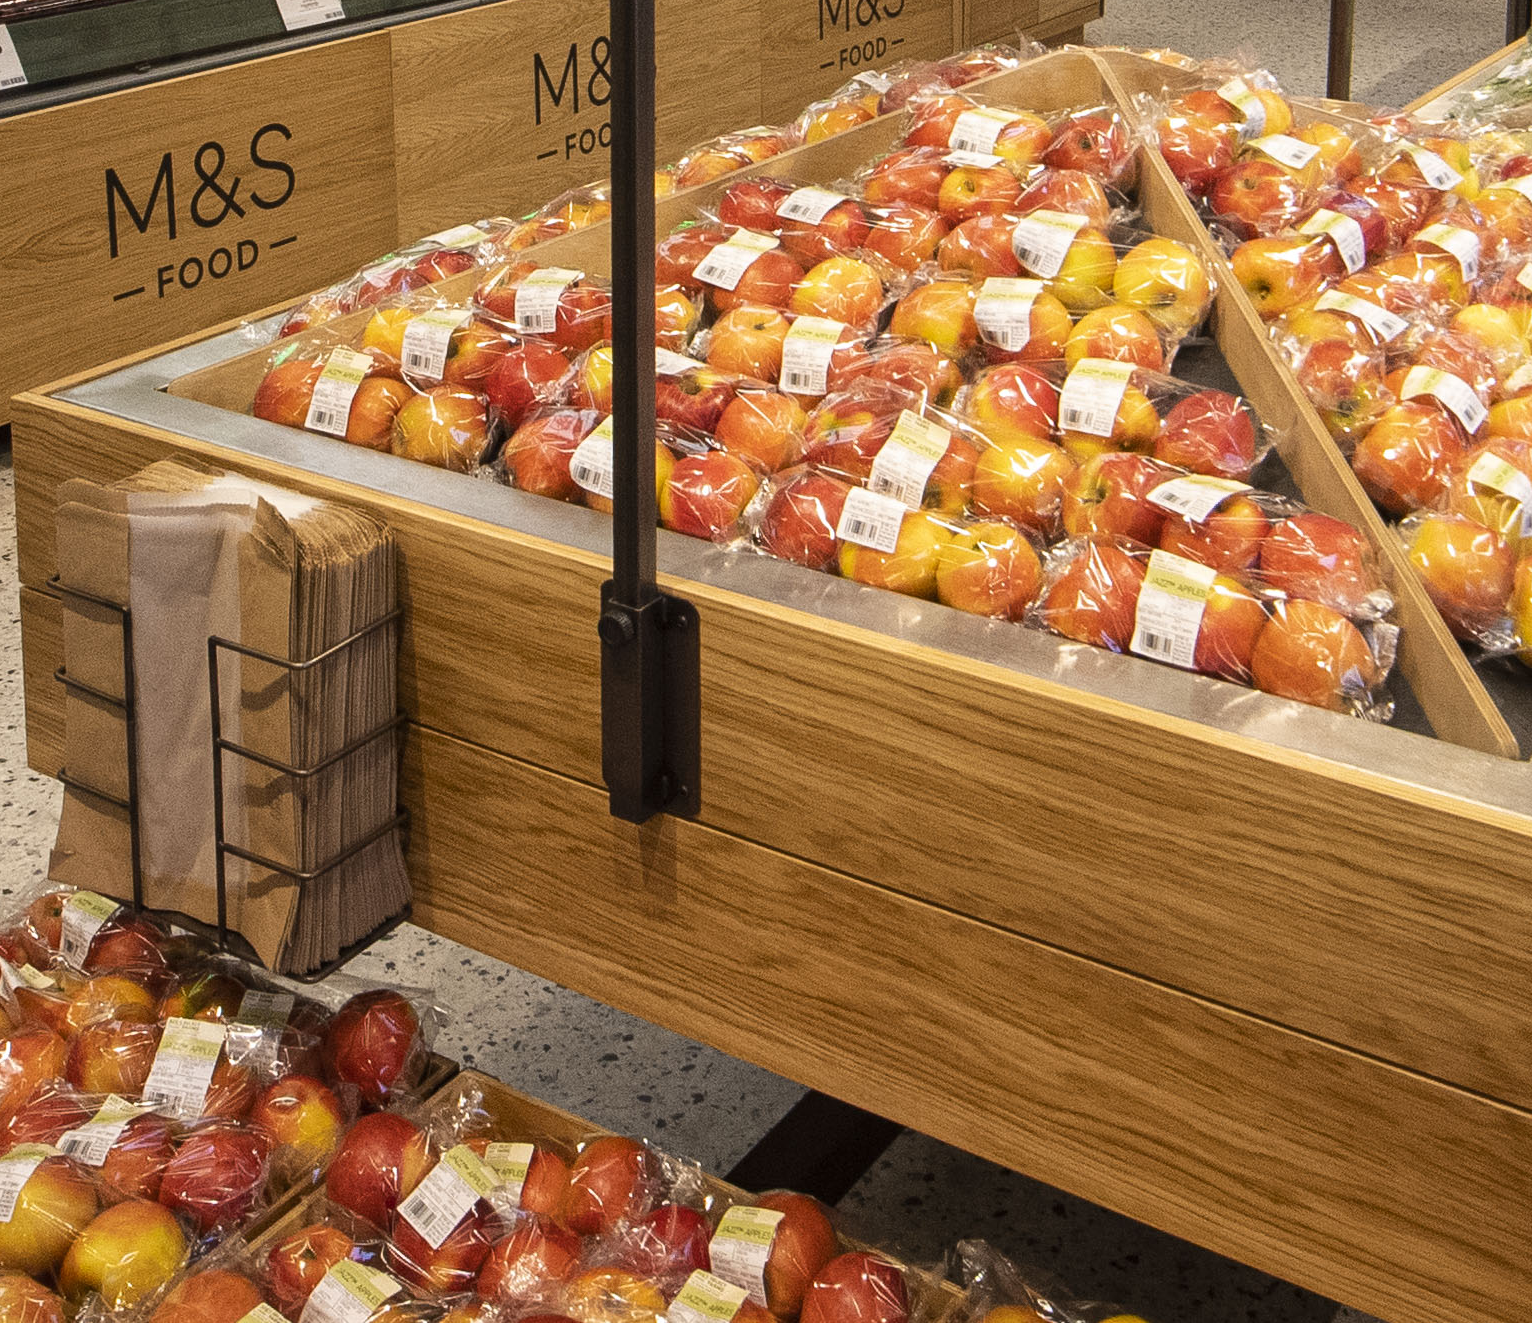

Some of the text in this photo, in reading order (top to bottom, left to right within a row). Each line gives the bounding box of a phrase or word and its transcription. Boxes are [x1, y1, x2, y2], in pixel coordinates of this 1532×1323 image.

[533, 34, 611, 125] M&
[839, 35, 887, 70] FOOD
[565, 122, 611, 160] FOO
[104, 122, 296, 259] M&S
[156, 237, 259, 299] FOOD
